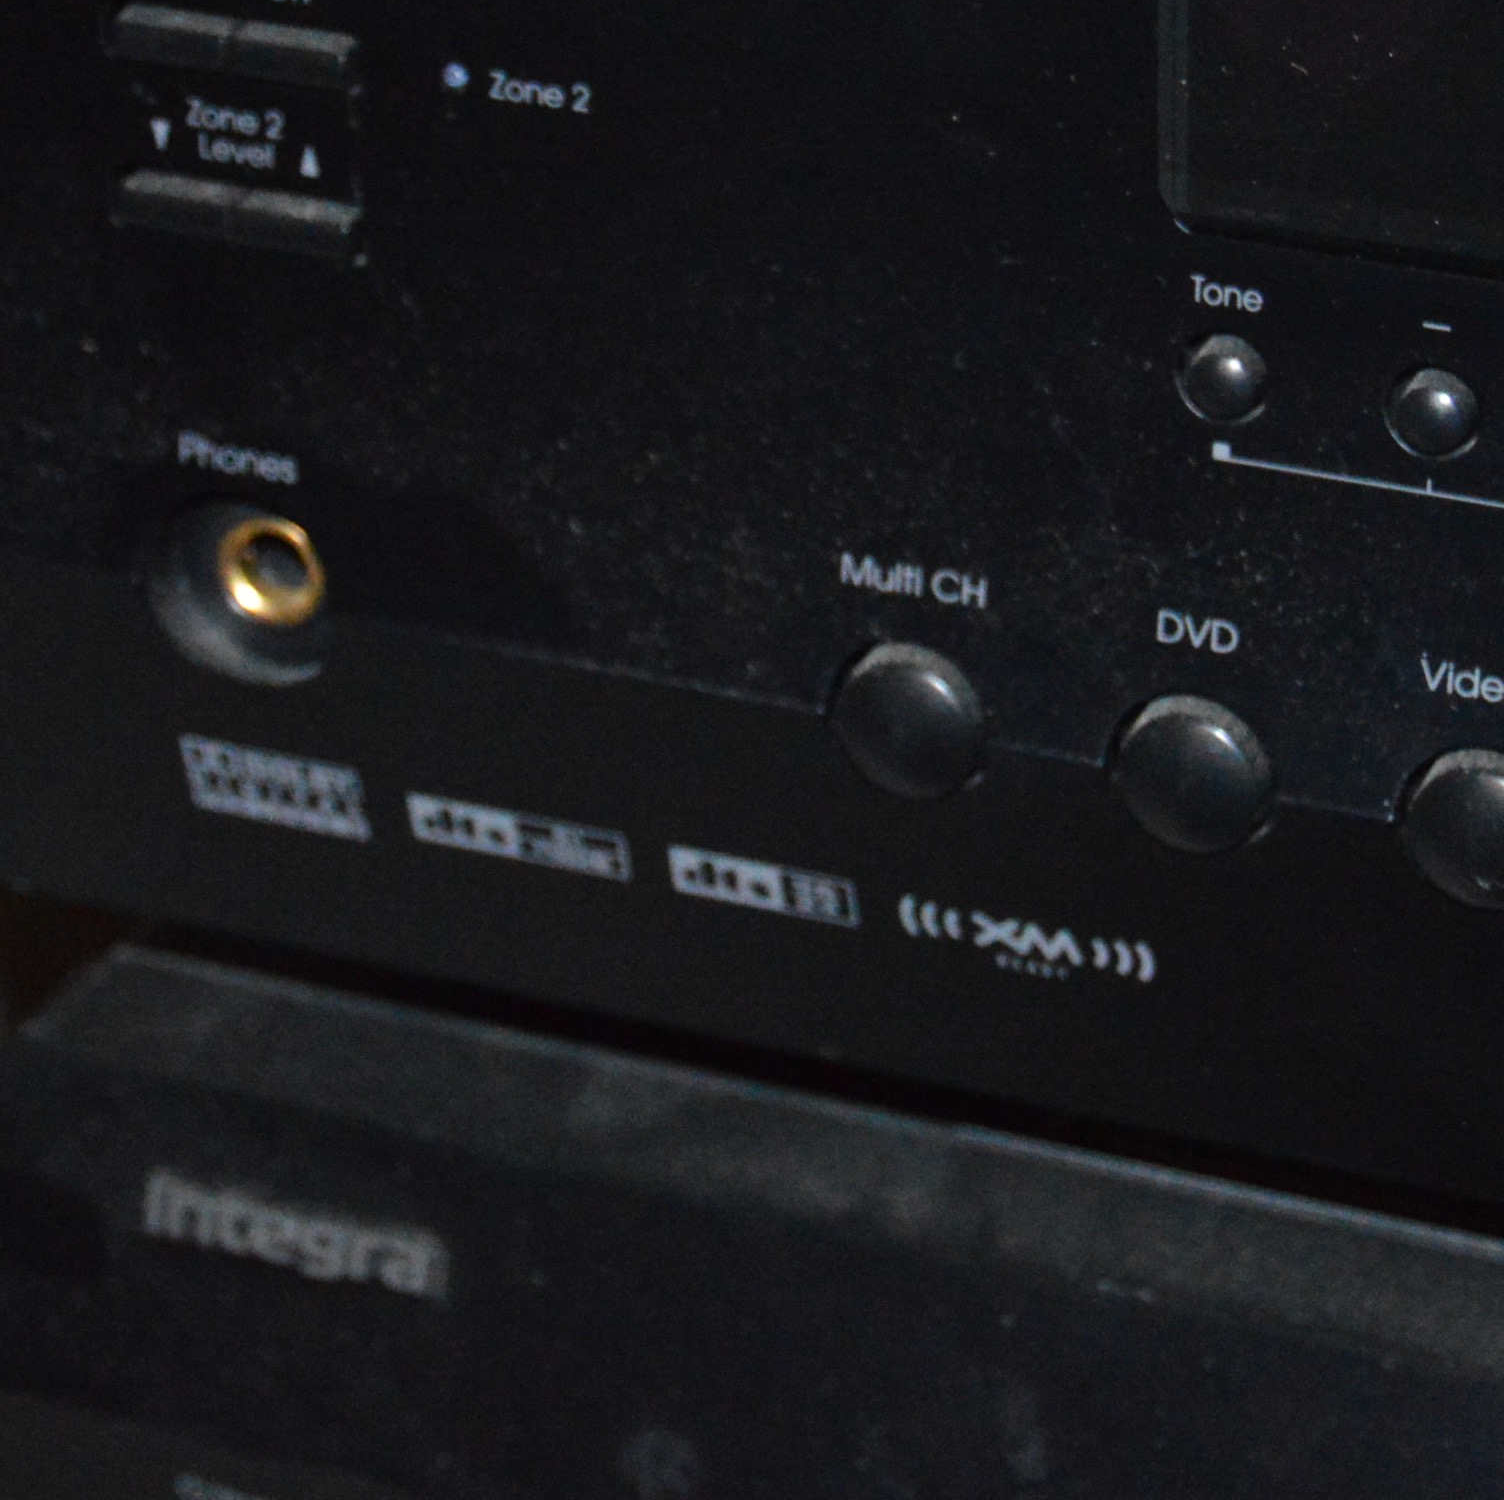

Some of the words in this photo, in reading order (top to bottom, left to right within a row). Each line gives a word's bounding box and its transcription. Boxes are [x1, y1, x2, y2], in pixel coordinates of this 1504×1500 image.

[489, 68, 566, 111] Zone
[571, 81, 591, 114] 2
[187, 95, 259, 137] Zone
[265, 108, 286, 141] 2
[198, 134, 277, 169] Level
[1191, 273, 1263, 313] Tone
[178, 430, 299, 486] Phones
[839, 551, 926, 597] Multi
[931, 570, 988, 608] CH
[1156, 608, 1240, 655] DVD
[971, 909, 1085, 967] XM
[141, 1167, 449, 1300] Integra
